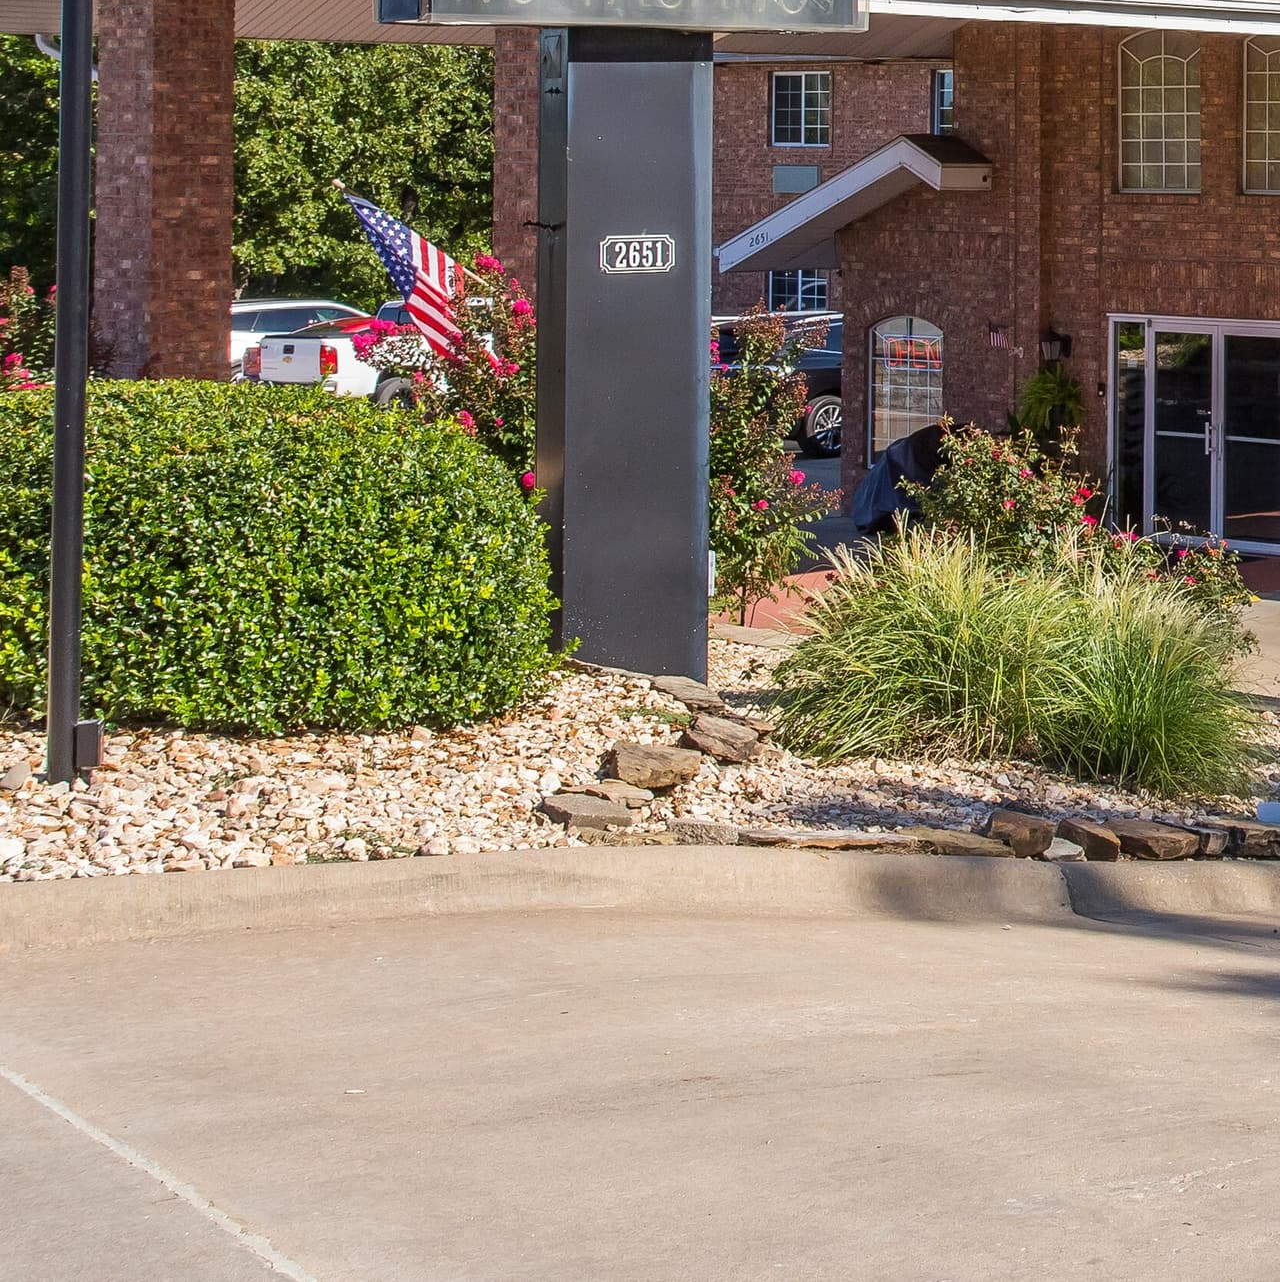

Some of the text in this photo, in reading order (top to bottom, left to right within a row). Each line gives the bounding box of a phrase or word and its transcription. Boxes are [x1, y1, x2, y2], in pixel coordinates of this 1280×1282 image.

[749, 231, 769, 248] 2651
[614, 241, 664, 268] 2651
[885, 337, 941, 369] OPEN
